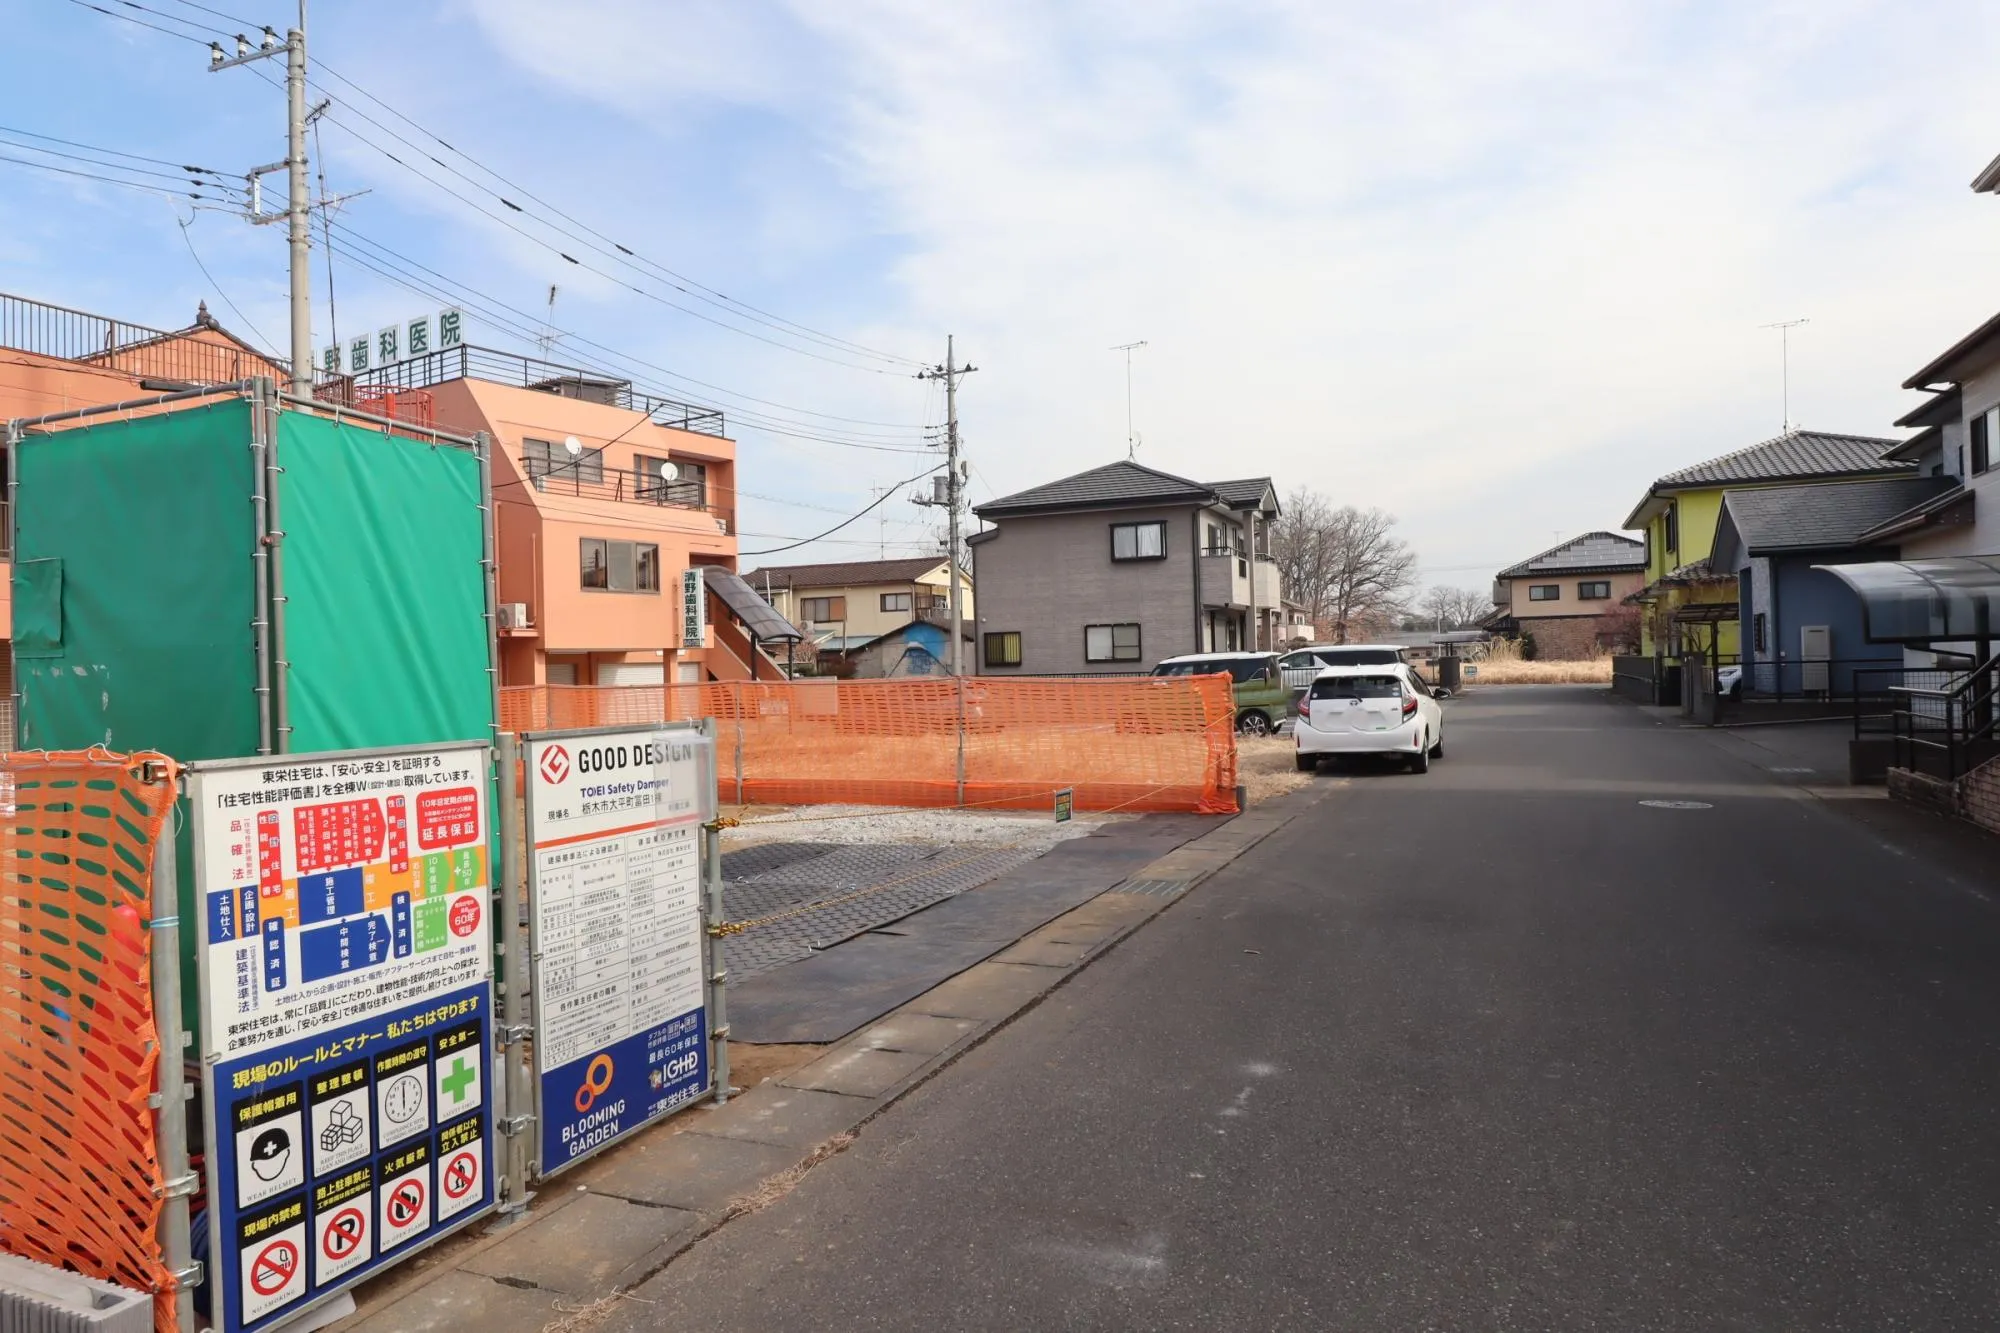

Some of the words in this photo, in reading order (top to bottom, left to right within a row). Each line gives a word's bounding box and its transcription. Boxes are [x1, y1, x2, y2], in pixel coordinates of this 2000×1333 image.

[311, 310, 461, 376] 野歯科医院
[578, 747, 627, 773] GOOD
[633, 743, 692, 766] DESIGN
[608, 782, 635, 796] Safety
[637, 778, 669, 792] Damper
[422, 821, 474, 841] 延長保証
[230, 820, 244, 880] 品確法
[244, 890, 255, 932] 企画・設計
[325, 877, 335, 915] 施工管理
[220, 895, 231, 938] 土地仕入
[340, 927, 350, 969] 中間検査
[367, 921, 377, 962] 完了検査
[236, 949, 250, 1013] 建築基準法
[233, 1032, 383, 1088] 現場のルールとマナー
[387, 996, 479, 1038] 私たちは守ります
[439, 1030, 476, 1050] 安全第一
[316, 1068, 363, 1095] 整理整頓
[239, 1092, 297, 1122] 保護帽着用
[657, 1083, 699, 1114] 東栄住宅
[562, 1099, 625, 1143] BLOOMING
[441, 1128, 477, 1153] 立入禁止
[569, 1120, 618, 1157] GARDEN
[385, 1147, 425, 1175] 火気厳禁
[247, 1189, 267, 1201] WEAR
[269, 1178, 297, 1194] HELMET
[317, 1168, 370, 1200] 路上駐車禁止
[244, 1202, 301, 1237] 現場内禁煙
[264, 1288, 295, 1309] SMOKING
